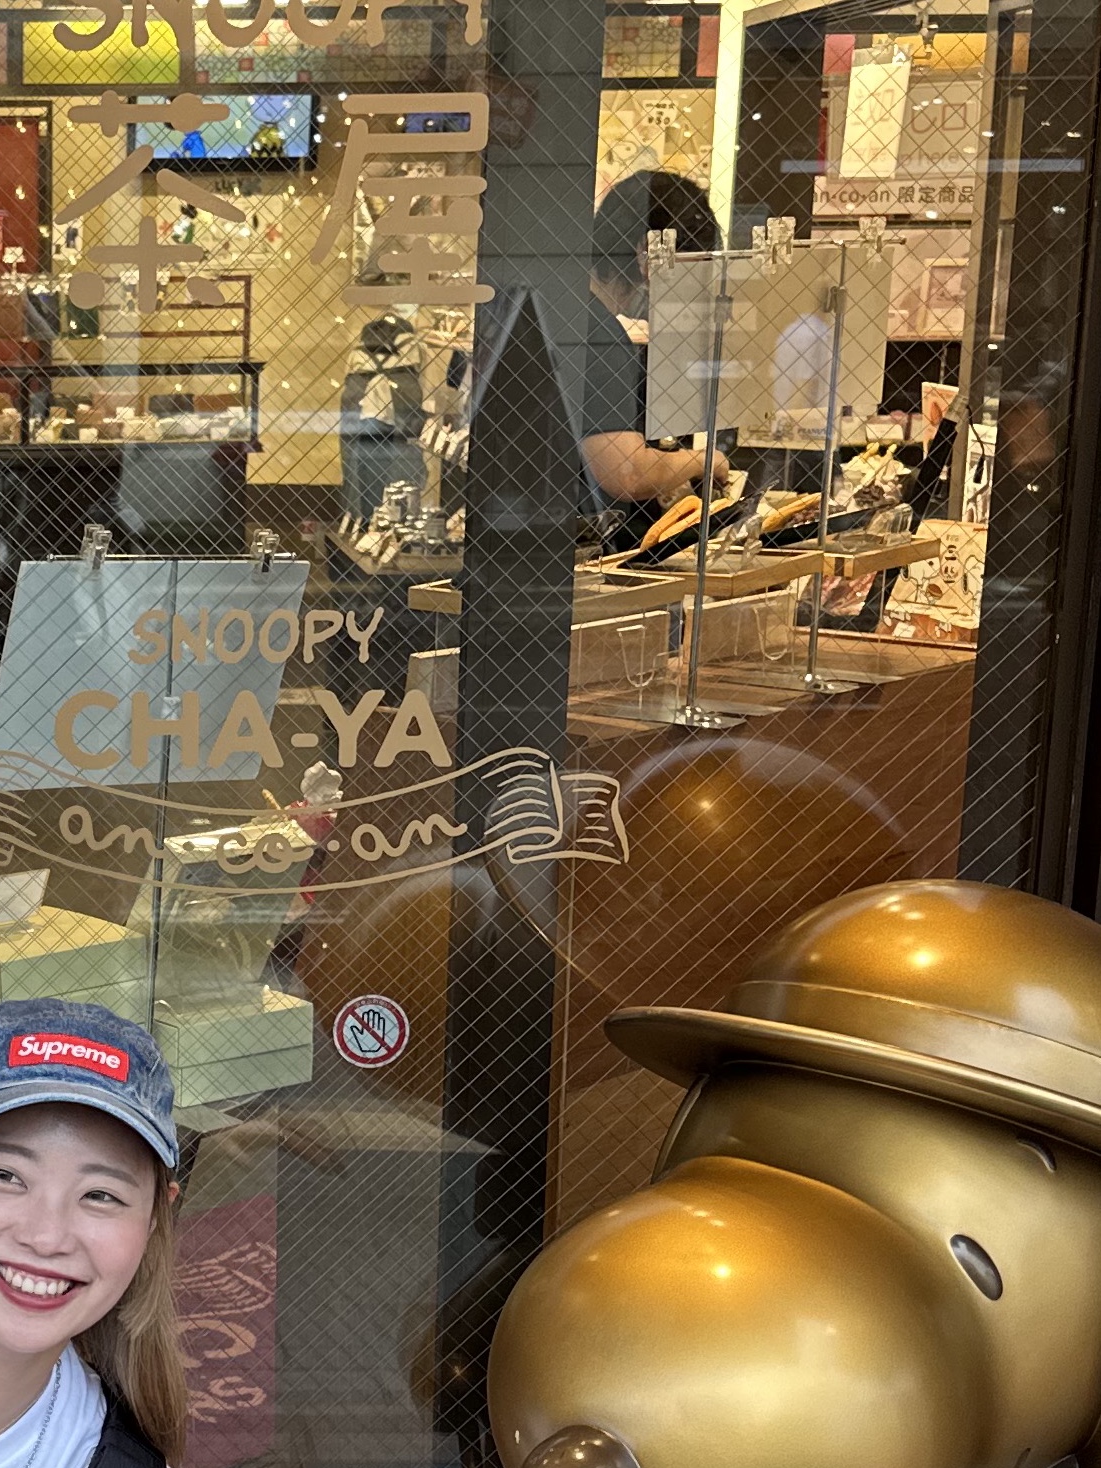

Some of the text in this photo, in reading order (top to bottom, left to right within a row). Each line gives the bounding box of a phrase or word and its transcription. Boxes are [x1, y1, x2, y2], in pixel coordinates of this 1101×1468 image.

[53, 90, 495, 314] 茶屋
[897, 185, 976, 204] 限定商品
[128, 606, 384, 665] SNOOPY
[54, 689, 452, 769] CHA-YA
[18, 1036, 121, 1069] Supreme
